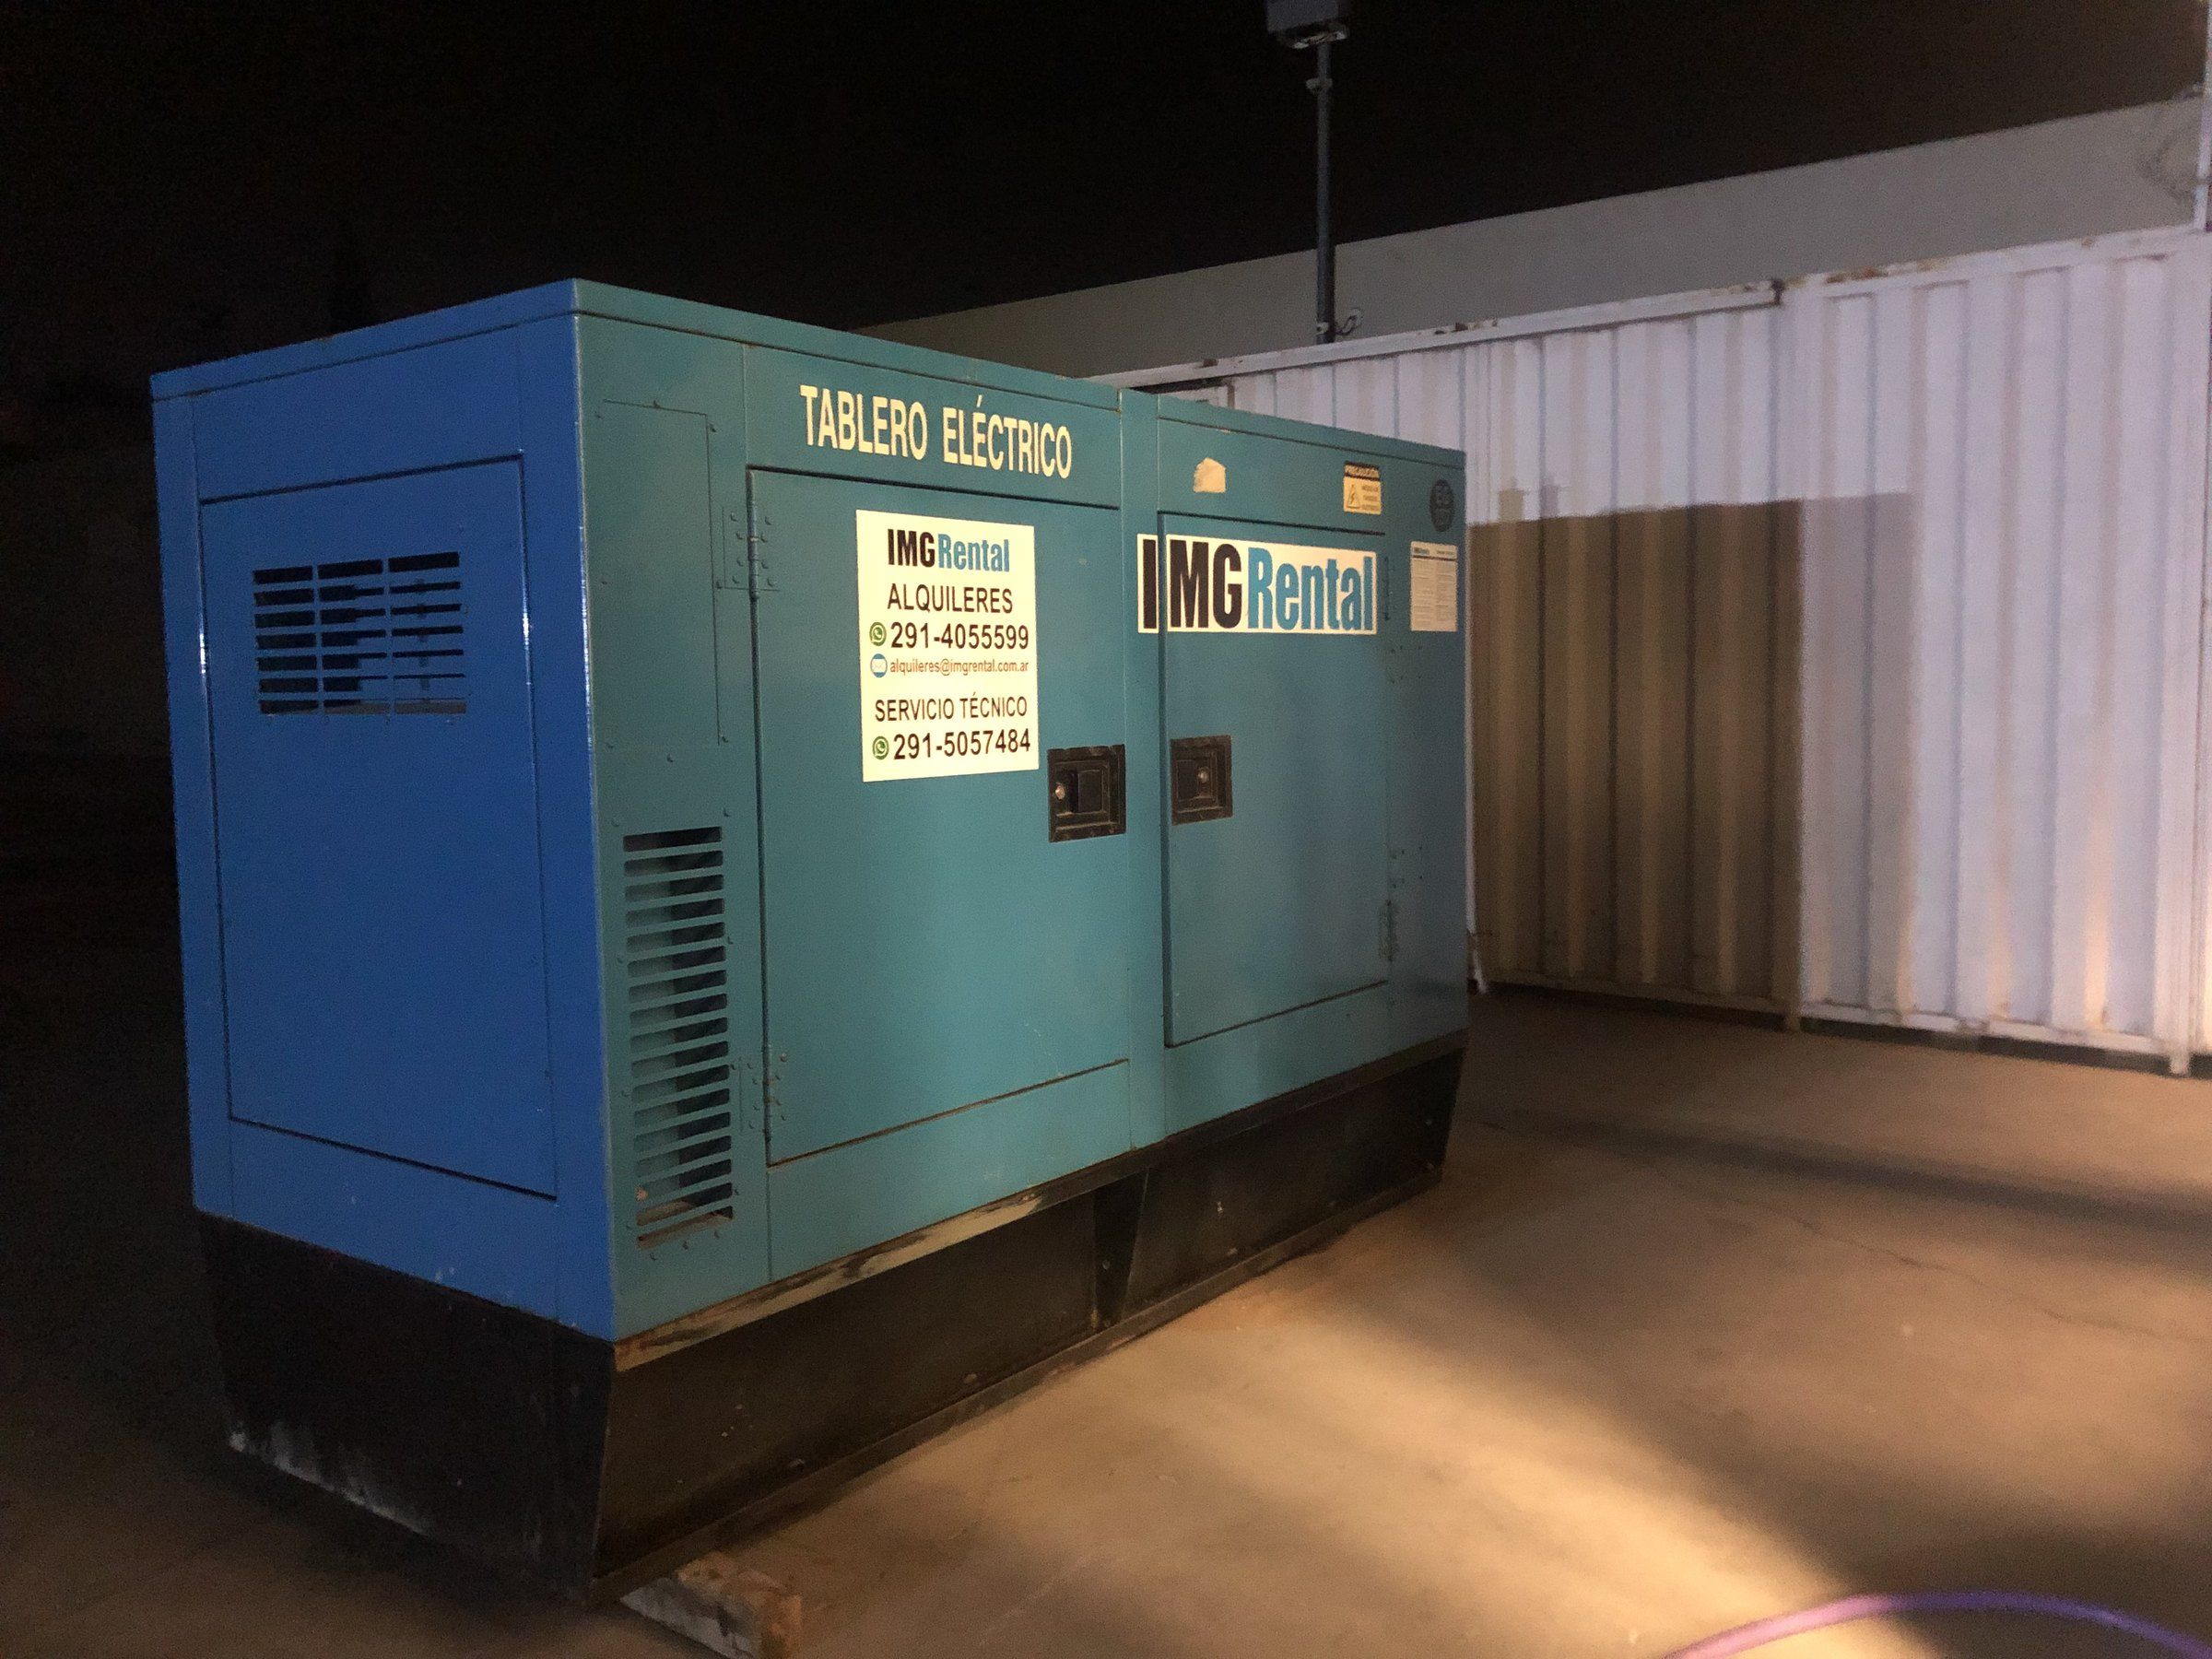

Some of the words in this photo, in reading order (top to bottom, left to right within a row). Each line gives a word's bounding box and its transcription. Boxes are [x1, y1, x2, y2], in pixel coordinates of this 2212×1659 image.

[799, 384, 927, 460] TABLERO
[943, 394, 1072, 478] ELÉCTRICO
[888, 583, 1013, 614] ALQUILERES
[890, 622, 1030, 650] 291-4055599
[889, 658, 1030, 676] alquileres@imgrental.com.ar
[875, 698, 955, 722] SERVICIO
[959, 691, 1028, 718] TÉCNICO
[893, 728, 1030, 760] 291-5057484
